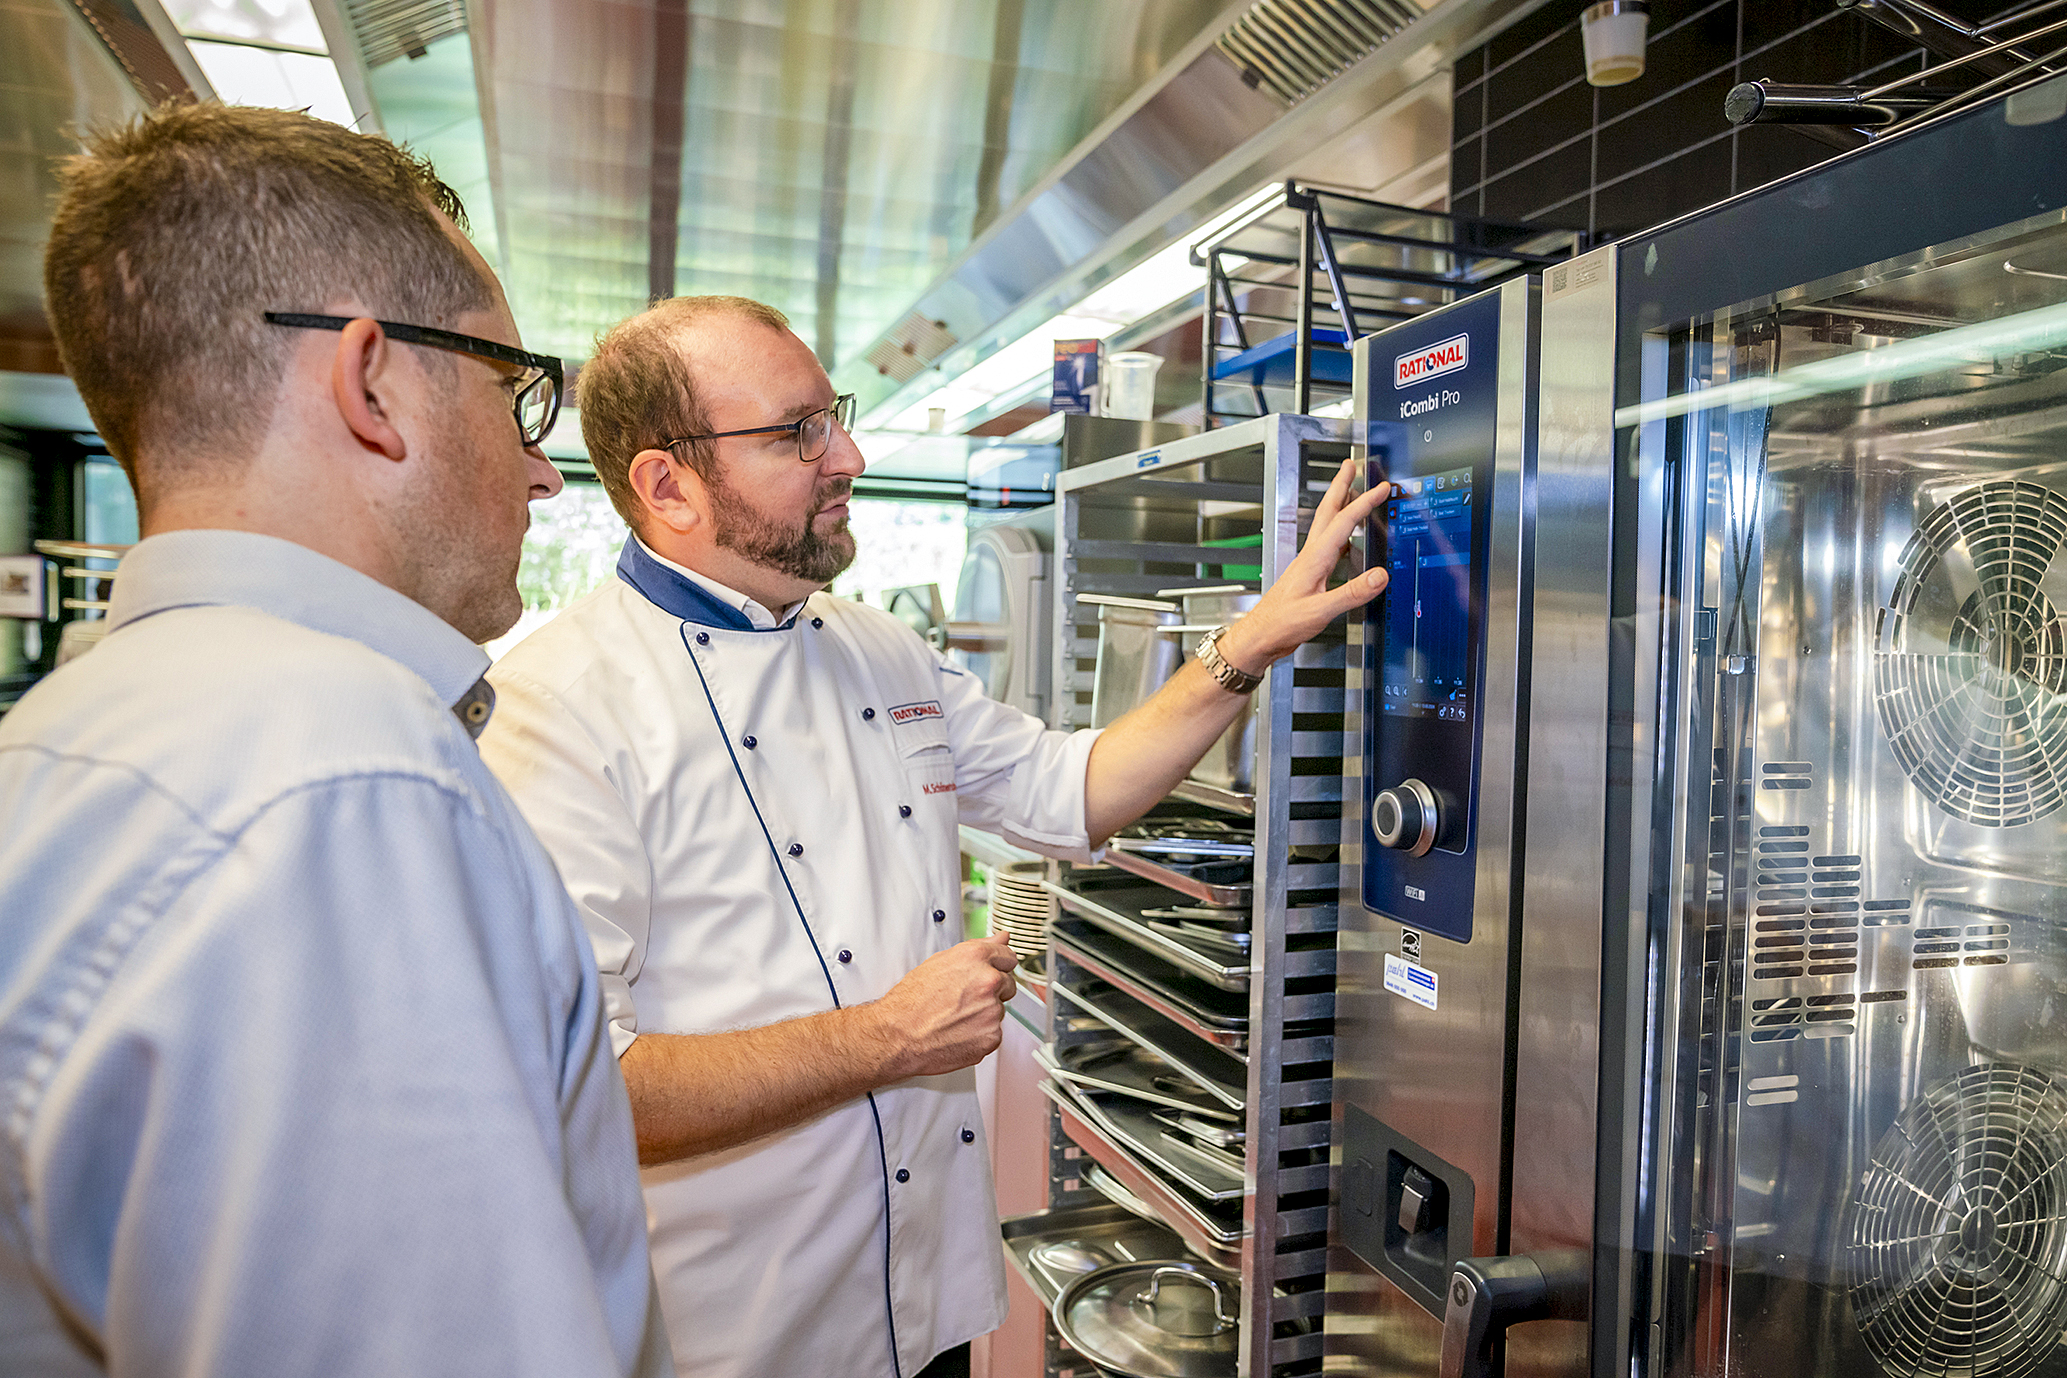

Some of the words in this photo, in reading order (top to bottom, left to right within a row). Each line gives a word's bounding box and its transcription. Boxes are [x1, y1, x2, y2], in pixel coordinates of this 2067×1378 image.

[1399, 345, 1463, 380] RATIONAL
[1400, 393, 1439, 418] iCombi
[1441, 390, 1460, 407] Pro
[893, 705, 940, 721] RATIONAL
